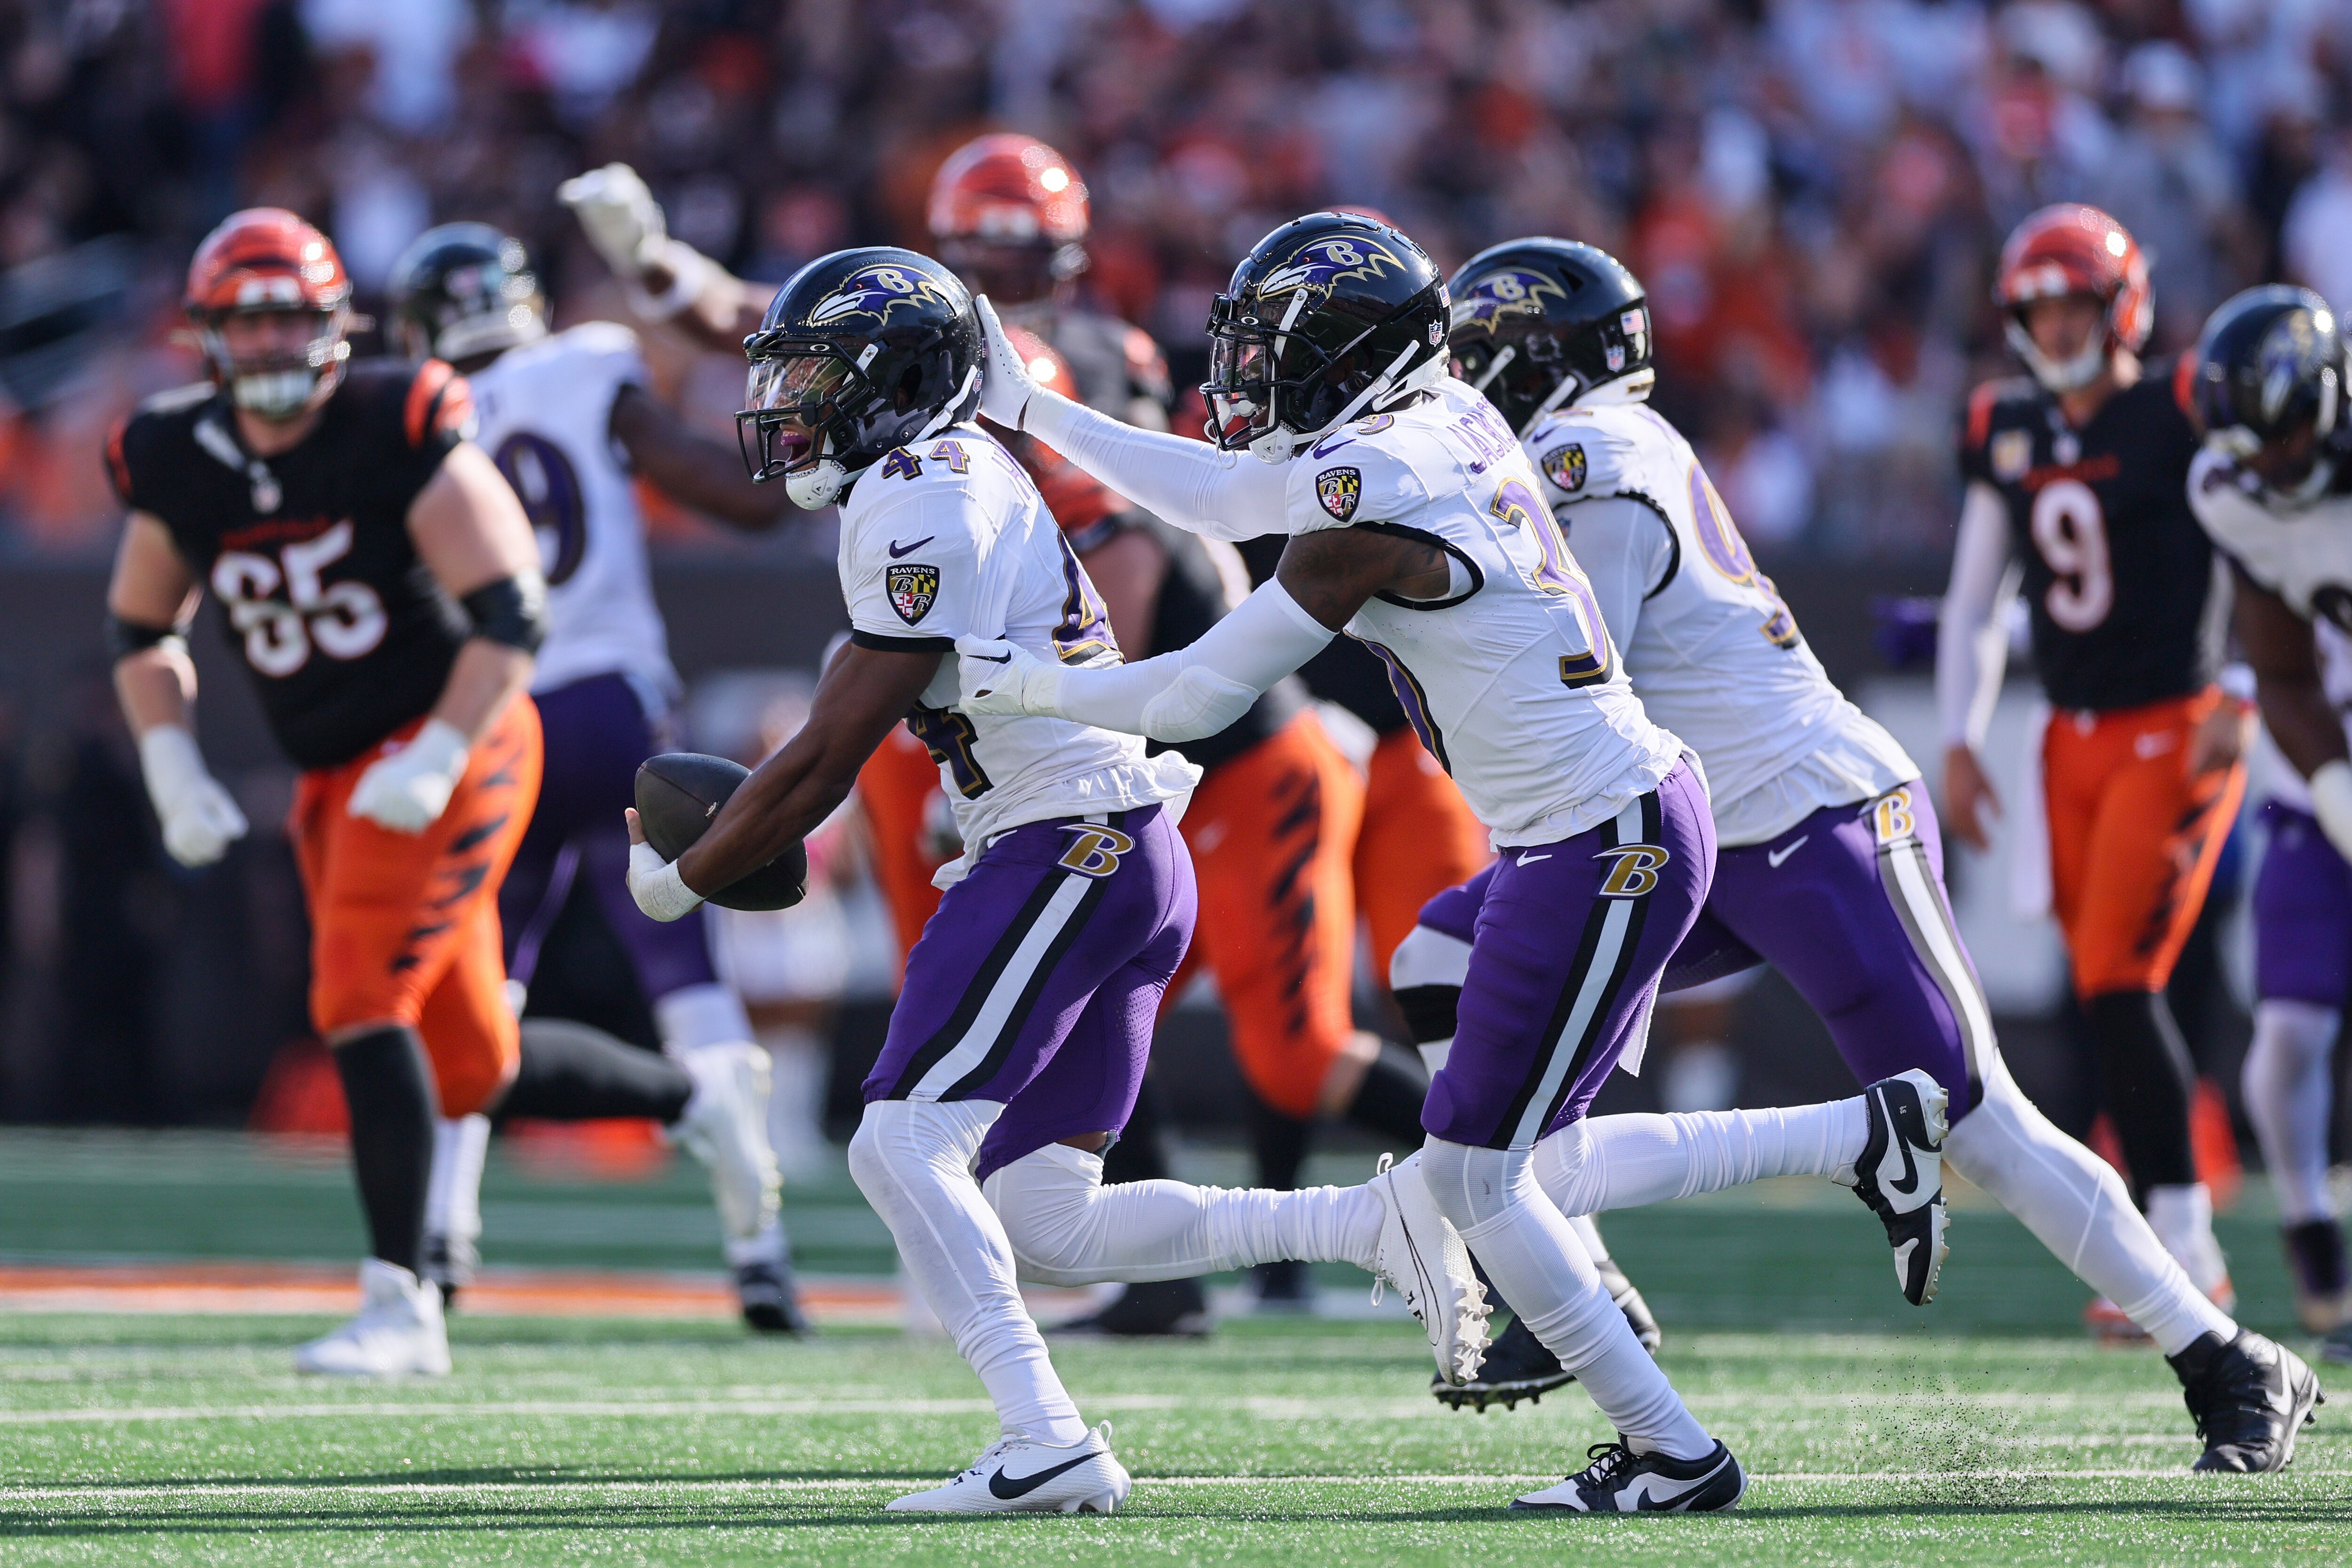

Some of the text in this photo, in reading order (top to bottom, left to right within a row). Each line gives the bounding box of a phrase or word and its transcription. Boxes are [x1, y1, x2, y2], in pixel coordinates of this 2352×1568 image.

[1311, 240, 1364, 266] B
[856, 269, 914, 293] B
[1446, 396, 1518, 474] JACKS
[881, 440, 970, 480] 44
[1318, 470, 1356, 481] RAVENS
[2030, 478, 2115, 634] 9
[211, 517, 389, 679] 65
[890, 575, 915, 592] B
[912, 593, 932, 611] R
[1057, 824, 1134, 876] B
[1592, 844, 1670, 897] B
